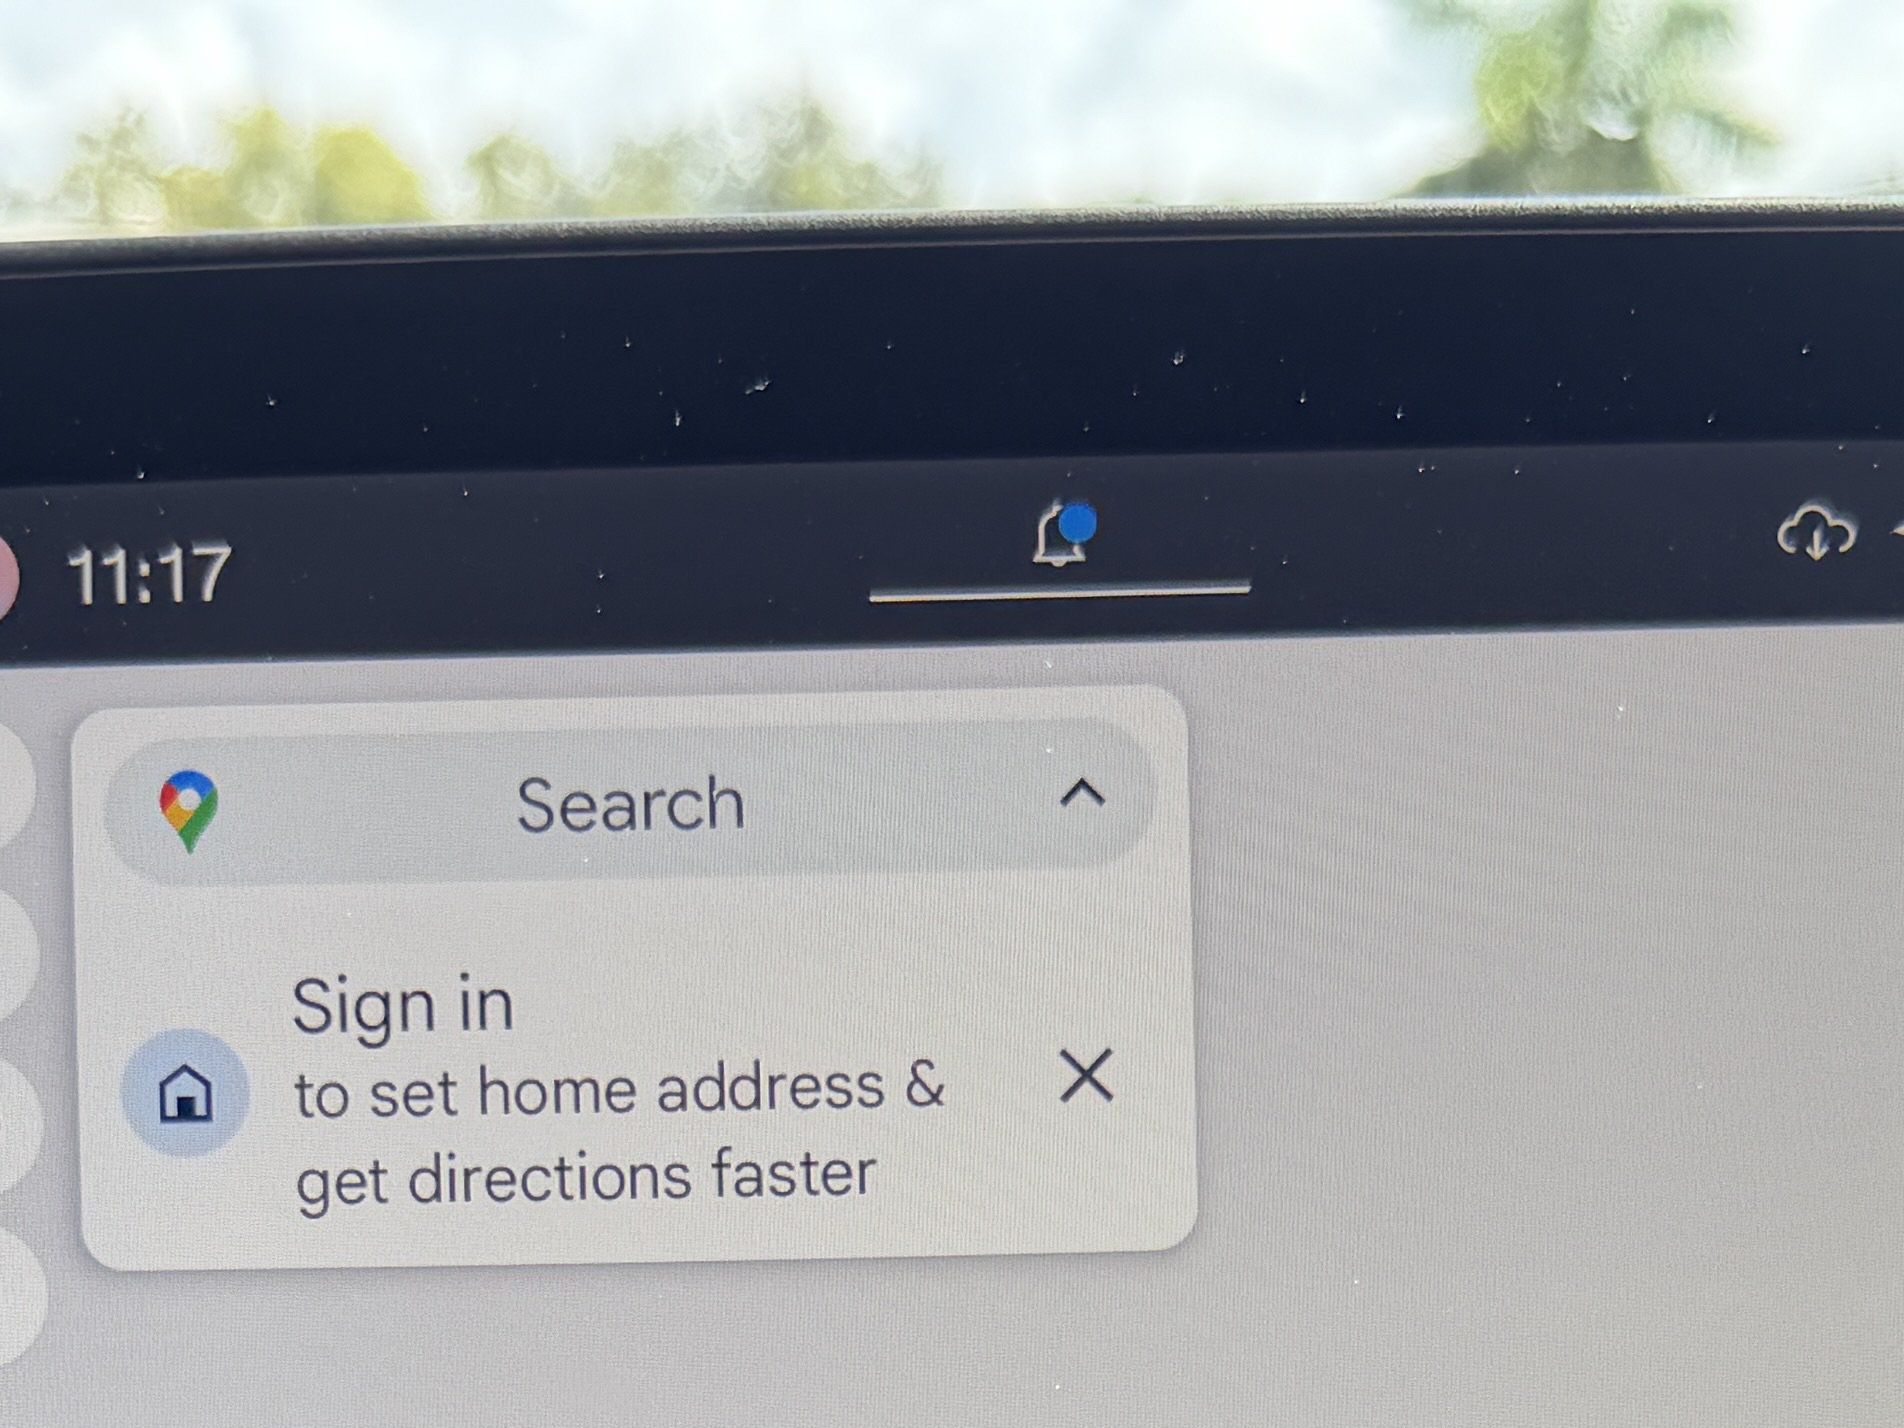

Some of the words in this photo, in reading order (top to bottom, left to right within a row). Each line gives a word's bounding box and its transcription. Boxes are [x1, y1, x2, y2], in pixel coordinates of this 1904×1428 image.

[69, 545, 231, 604] 11:17
[519, 774, 743, 833] Search
[294, 975, 433, 1049] Sign
[462, 973, 511, 1030] in
[295, 1075, 348, 1118] to
[372, 1072, 457, 1117] set
[480, 1064, 636, 1115] home
[659, 1059, 884, 1112] address
[907, 1059, 944, 1107] &
[298, 1160, 388, 1219] get
[409, 1149, 691, 1203] directions
[711, 1146, 877, 1197] faster
